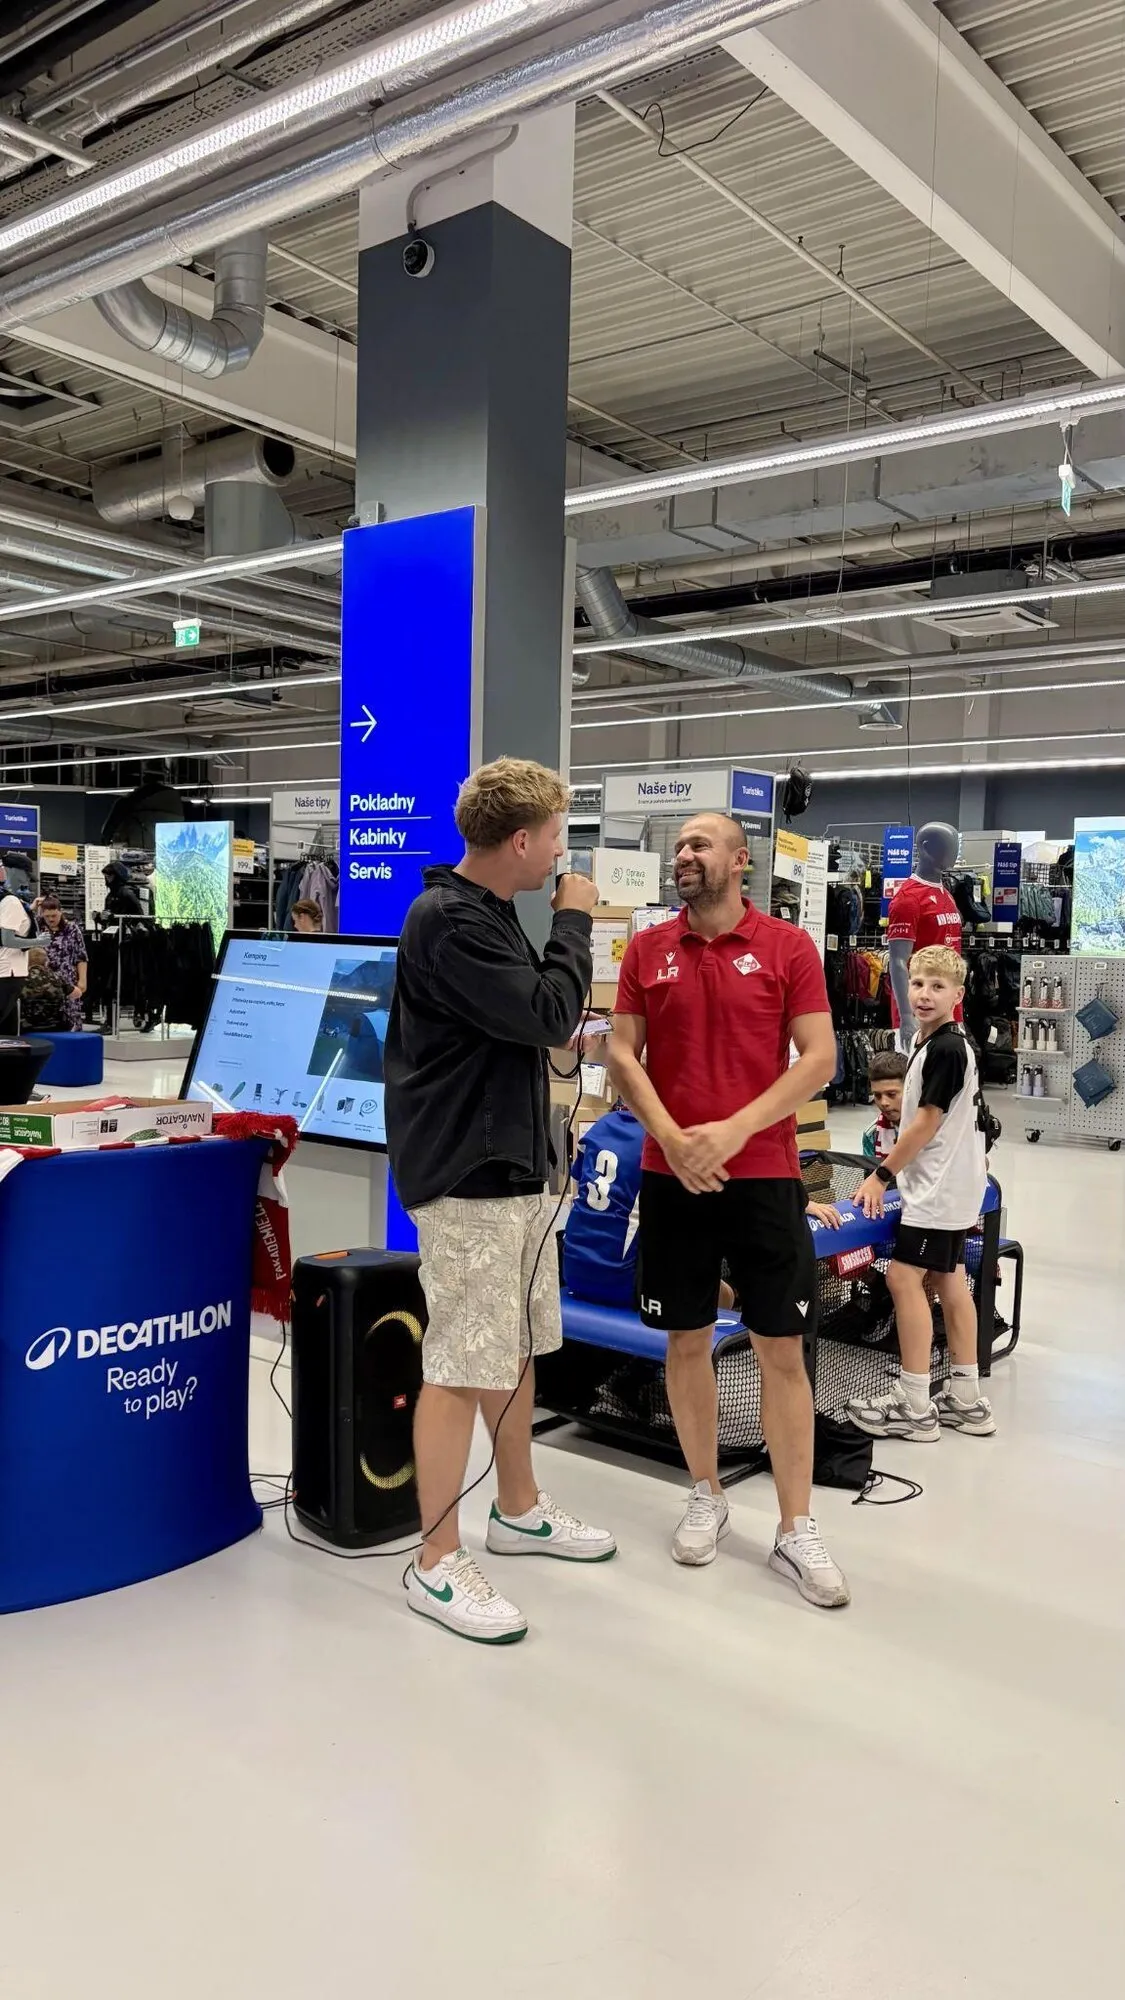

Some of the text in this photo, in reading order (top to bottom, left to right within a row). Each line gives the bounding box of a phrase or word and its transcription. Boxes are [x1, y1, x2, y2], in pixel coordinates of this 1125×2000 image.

[638, 780, 692, 796] Naše tipy
[742, 785, 764, 797] Turistika
[294, 796, 331, 809] Naše tipy
[349, 793, 415, 814] Pokladny
[349, 828, 406, 848] Kabinky
[349, 862, 392, 880] Servis
[657, 966, 679, 981] LR
[587, 1149, 619, 1212] 3
[641, 1294, 662, 1316] LR
[77, 1300, 232, 1359] DECATHLON
[107, 1357, 179, 1393] Ready
[124, 1376, 198, 1419] to play?
